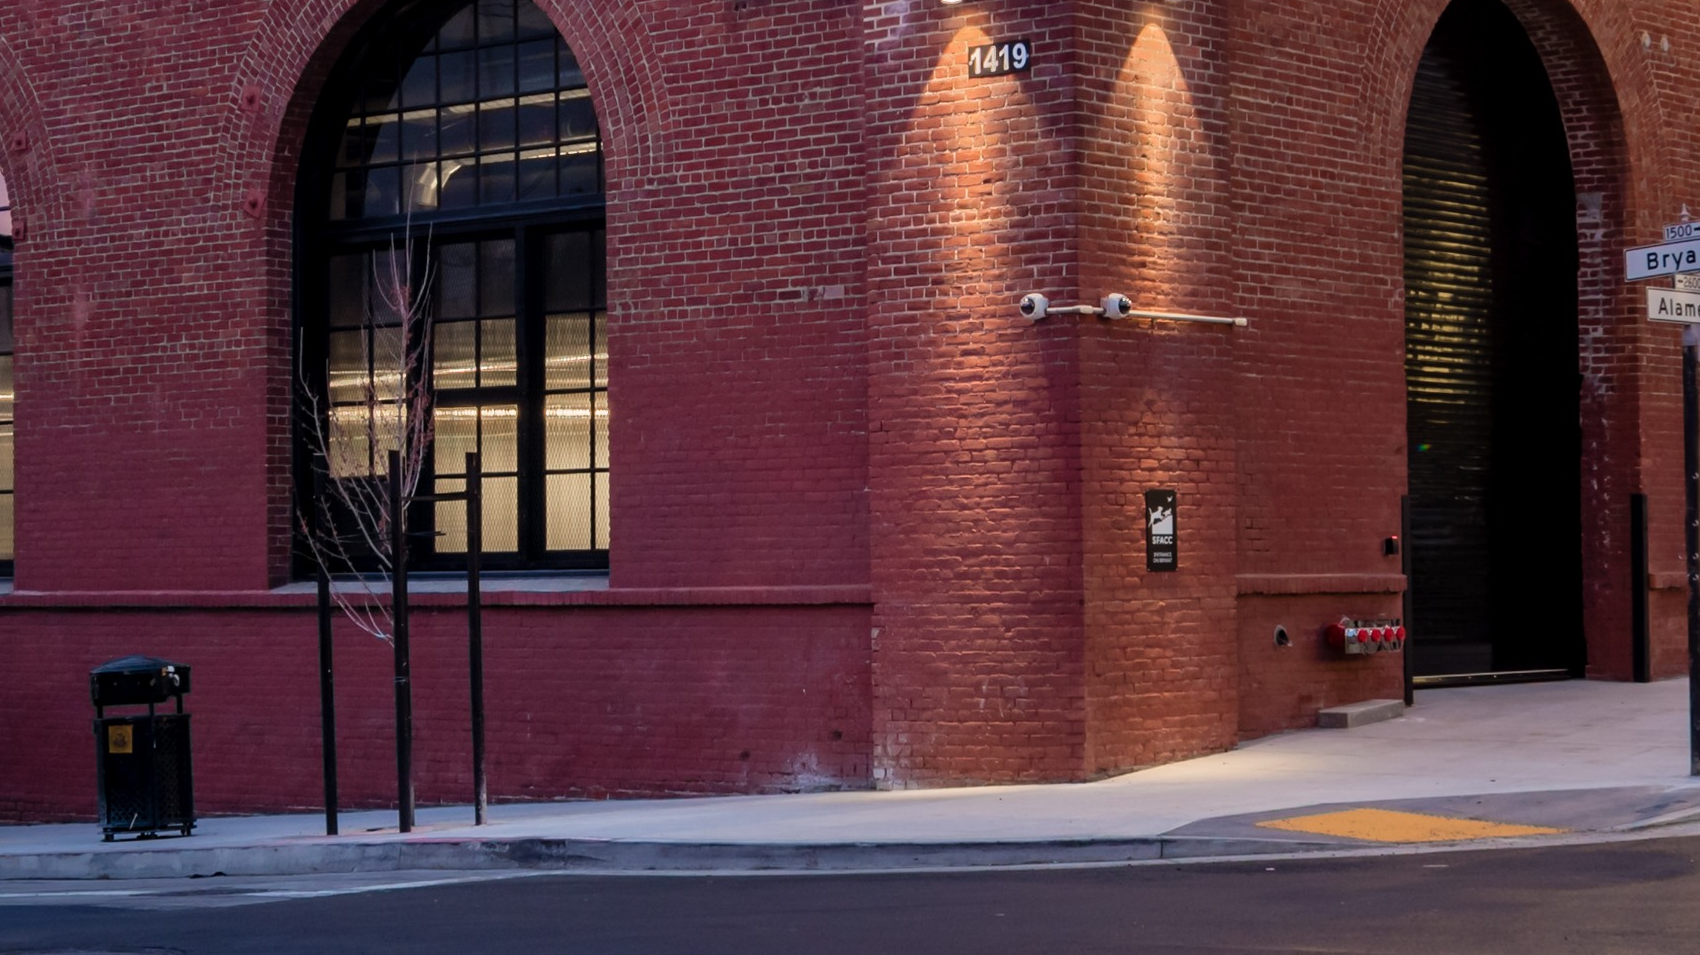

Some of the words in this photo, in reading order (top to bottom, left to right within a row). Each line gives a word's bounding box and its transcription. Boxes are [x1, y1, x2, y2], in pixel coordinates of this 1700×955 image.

[970, 43, 1027, 75] 1419
[1666, 225, 1692, 239] 1500
[1152, 536, 1173, 545] SFACC
